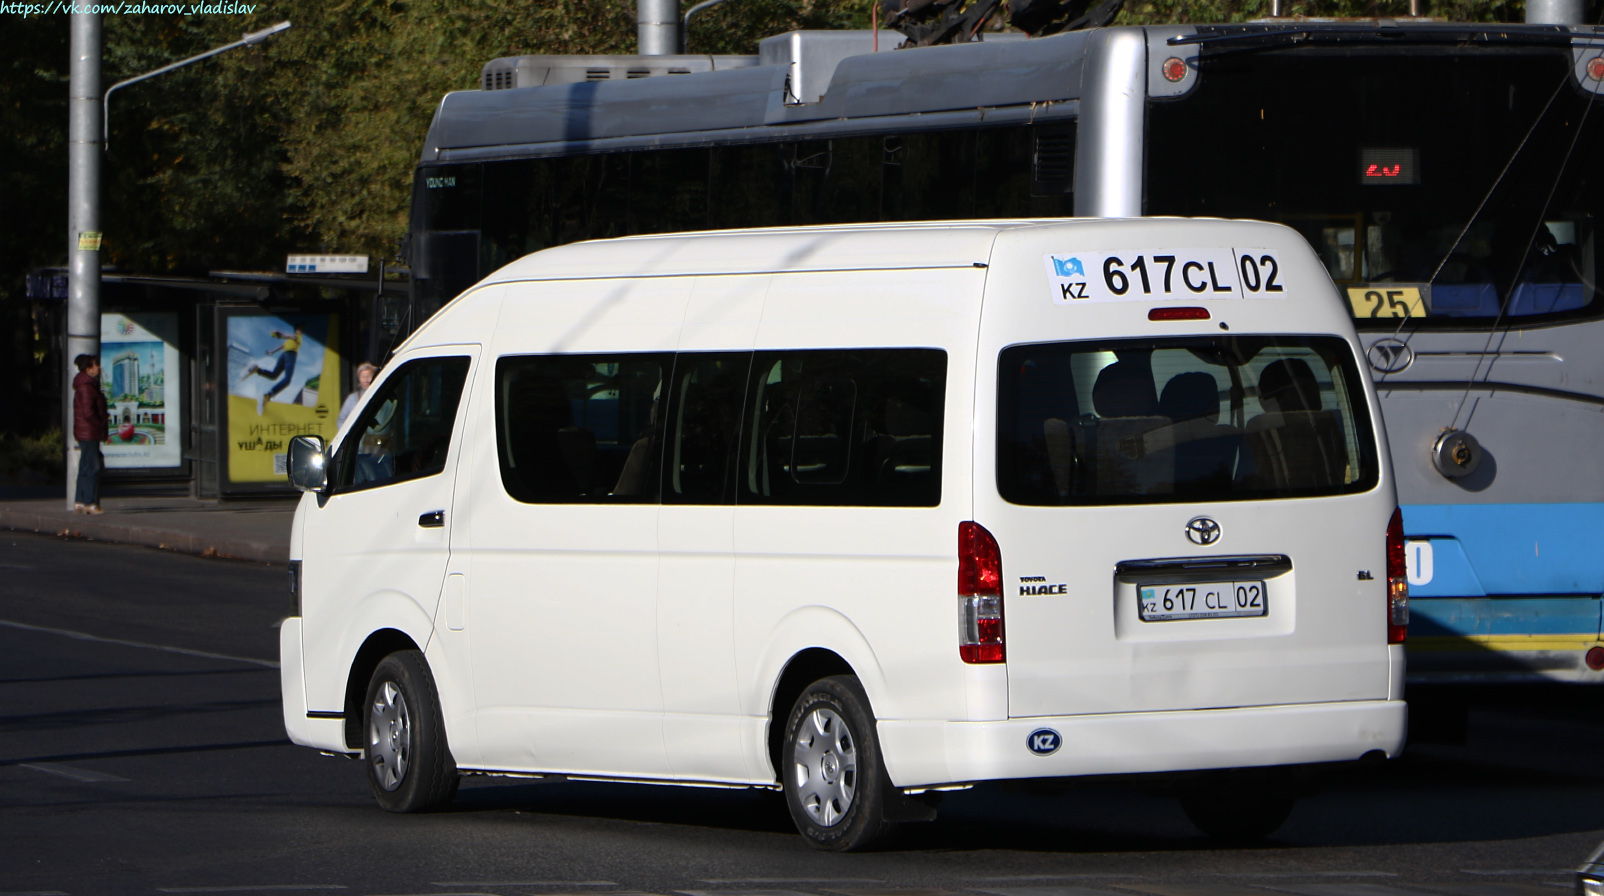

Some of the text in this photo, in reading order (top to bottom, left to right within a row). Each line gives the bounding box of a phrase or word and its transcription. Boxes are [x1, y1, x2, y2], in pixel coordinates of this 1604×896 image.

[1240, 254, 1284, 293] 02
[1060, 282, 1090, 300] KZ
[249, 423, 324, 436] ИНТЕРНЕТ
[1019, 584, 1068, 596] HIACE
[1163, 585, 1261, 611] 617 CL 02
[1142, 602, 1157, 613] KZ
[1033, 734, 1055, 750] KZ
